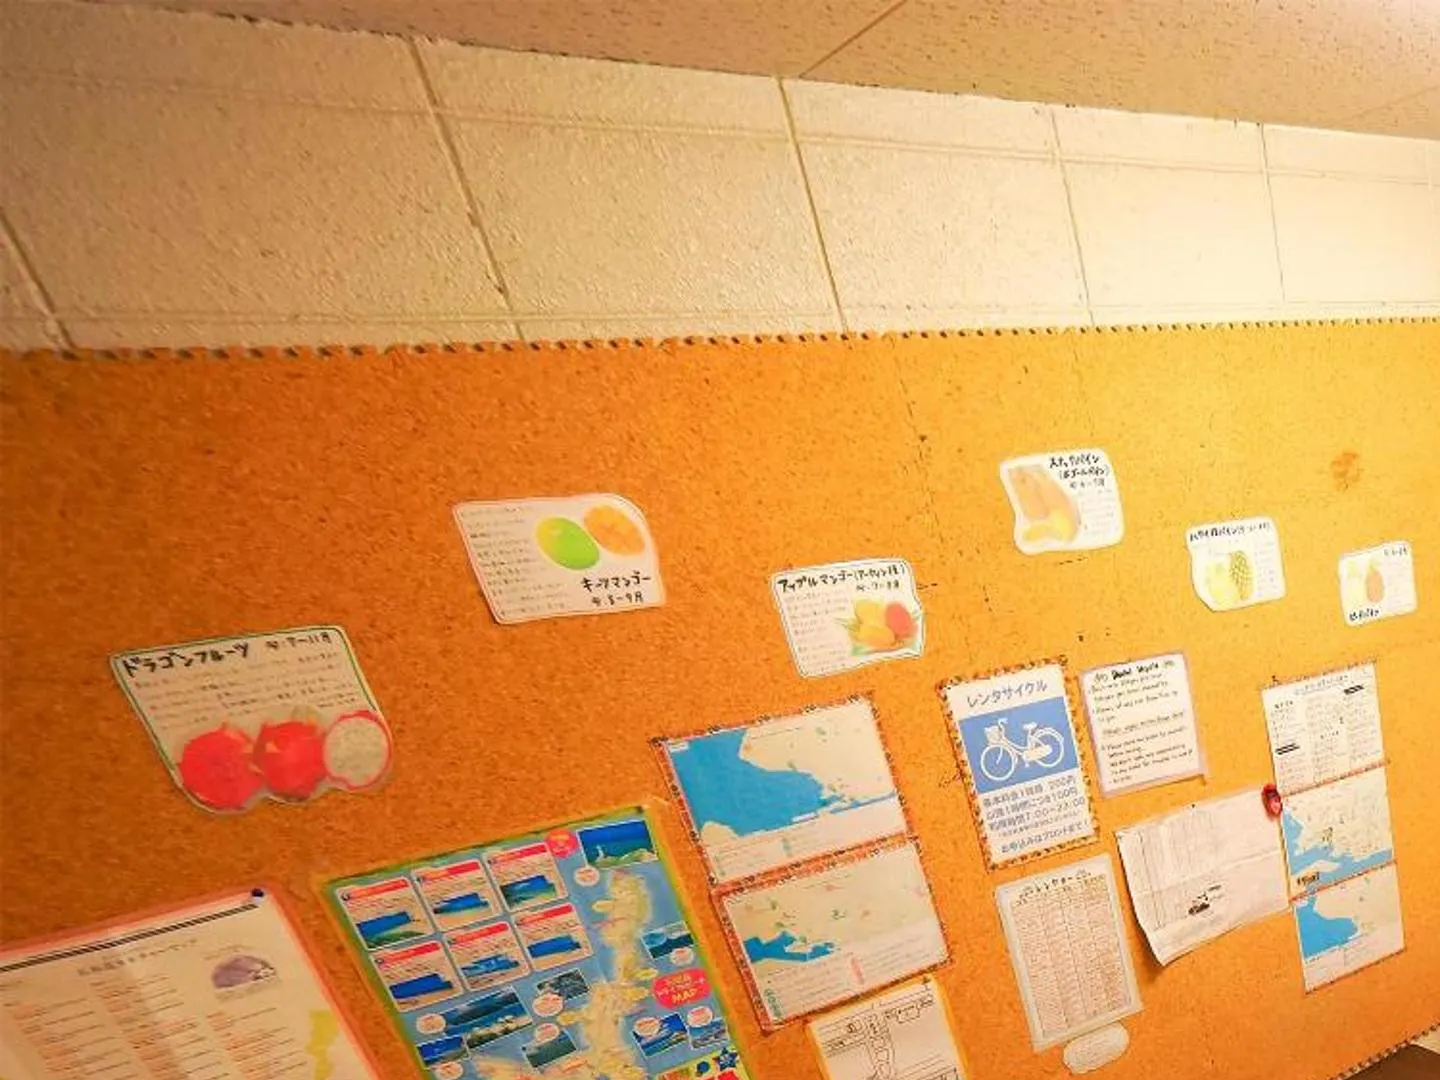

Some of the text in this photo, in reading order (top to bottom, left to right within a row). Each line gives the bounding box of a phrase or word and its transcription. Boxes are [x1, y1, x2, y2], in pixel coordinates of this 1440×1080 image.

[581, 570, 652, 592] キーツマンゴー
[123, 642, 249, 678] ドラゴンフルーツ
[966, 680, 1048, 708] レンタサイクル
